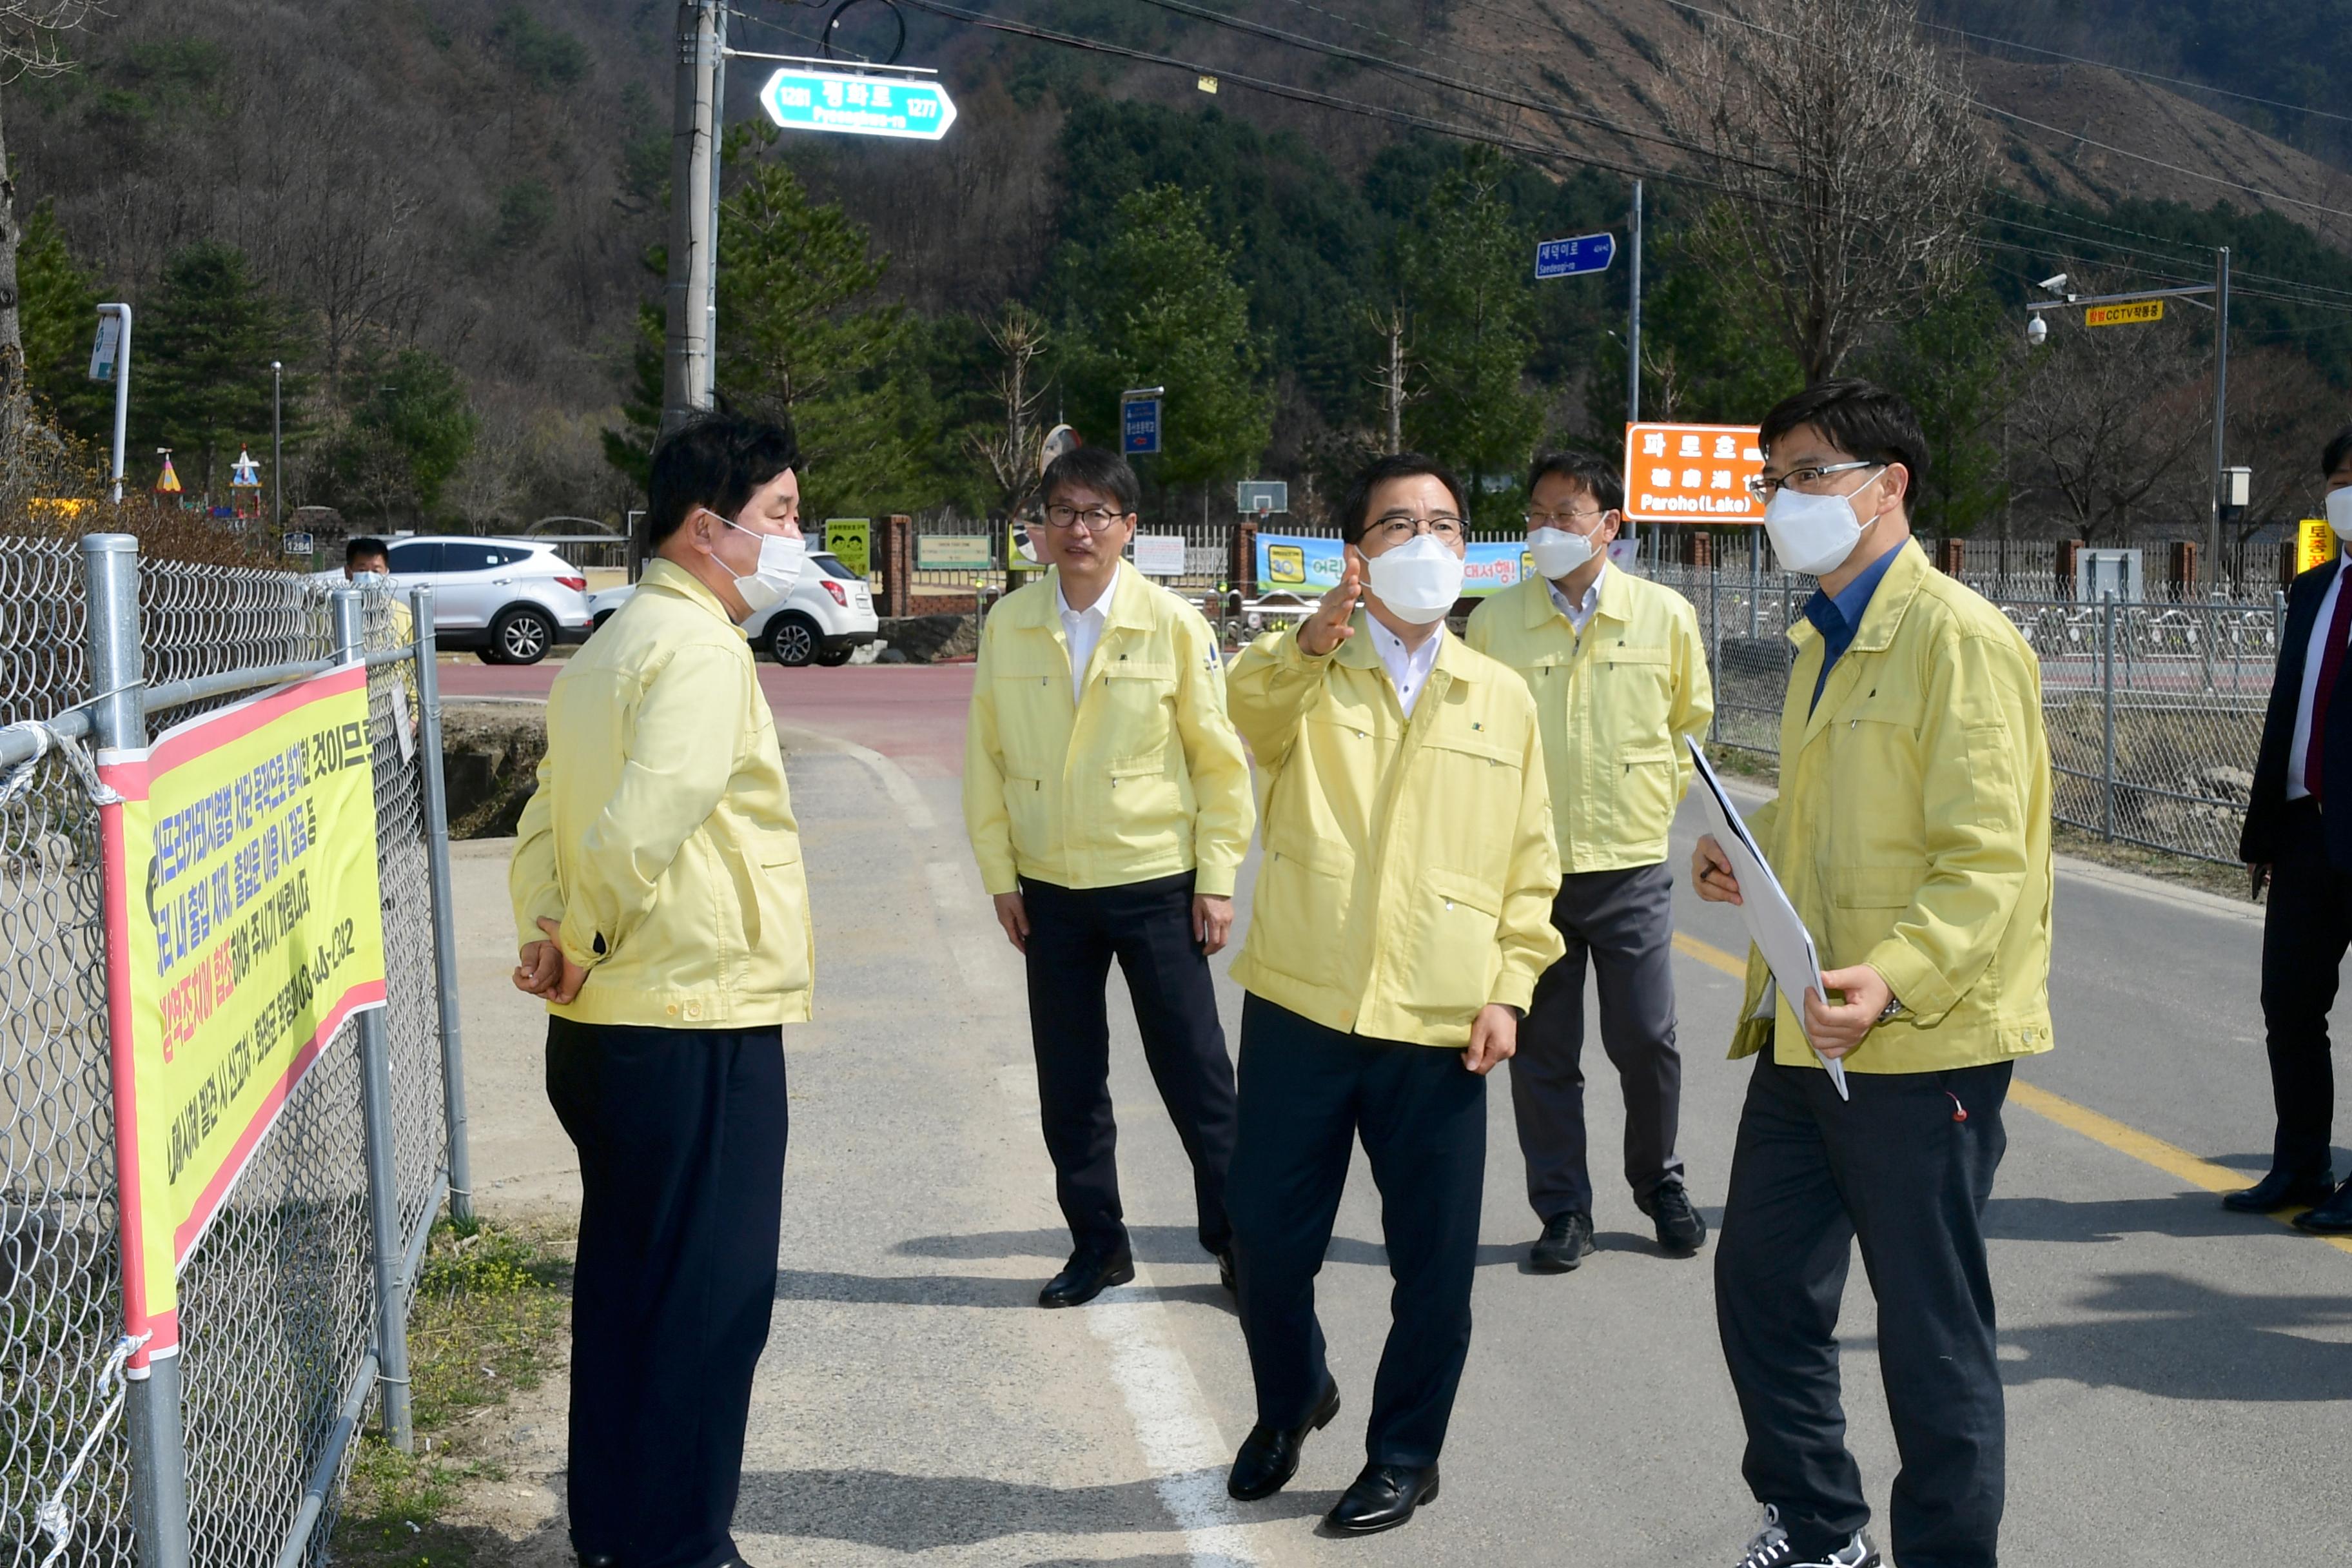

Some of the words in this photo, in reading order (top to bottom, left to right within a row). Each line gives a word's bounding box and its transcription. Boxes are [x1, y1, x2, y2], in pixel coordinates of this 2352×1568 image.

[780, 86, 810, 107] 1281
[822, 81, 892, 108] 평화로
[906, 99, 937, 118] 1277
[1541, 242, 1578, 259] 새덕이로
[235, 772, 253, 832] 차단
[253, 753, 286, 819] 목적으로
[188, 876, 210, 950] 출입
[234, 838, 260, 910] 출입문
[263, 823, 279, 884] 이용
[214, 919, 250, 1008] 협조하여
[251, 894, 277, 967] 주시기
[277, 868, 309, 937] 바랍니다
[199, 1072, 218, 1140] 발견
